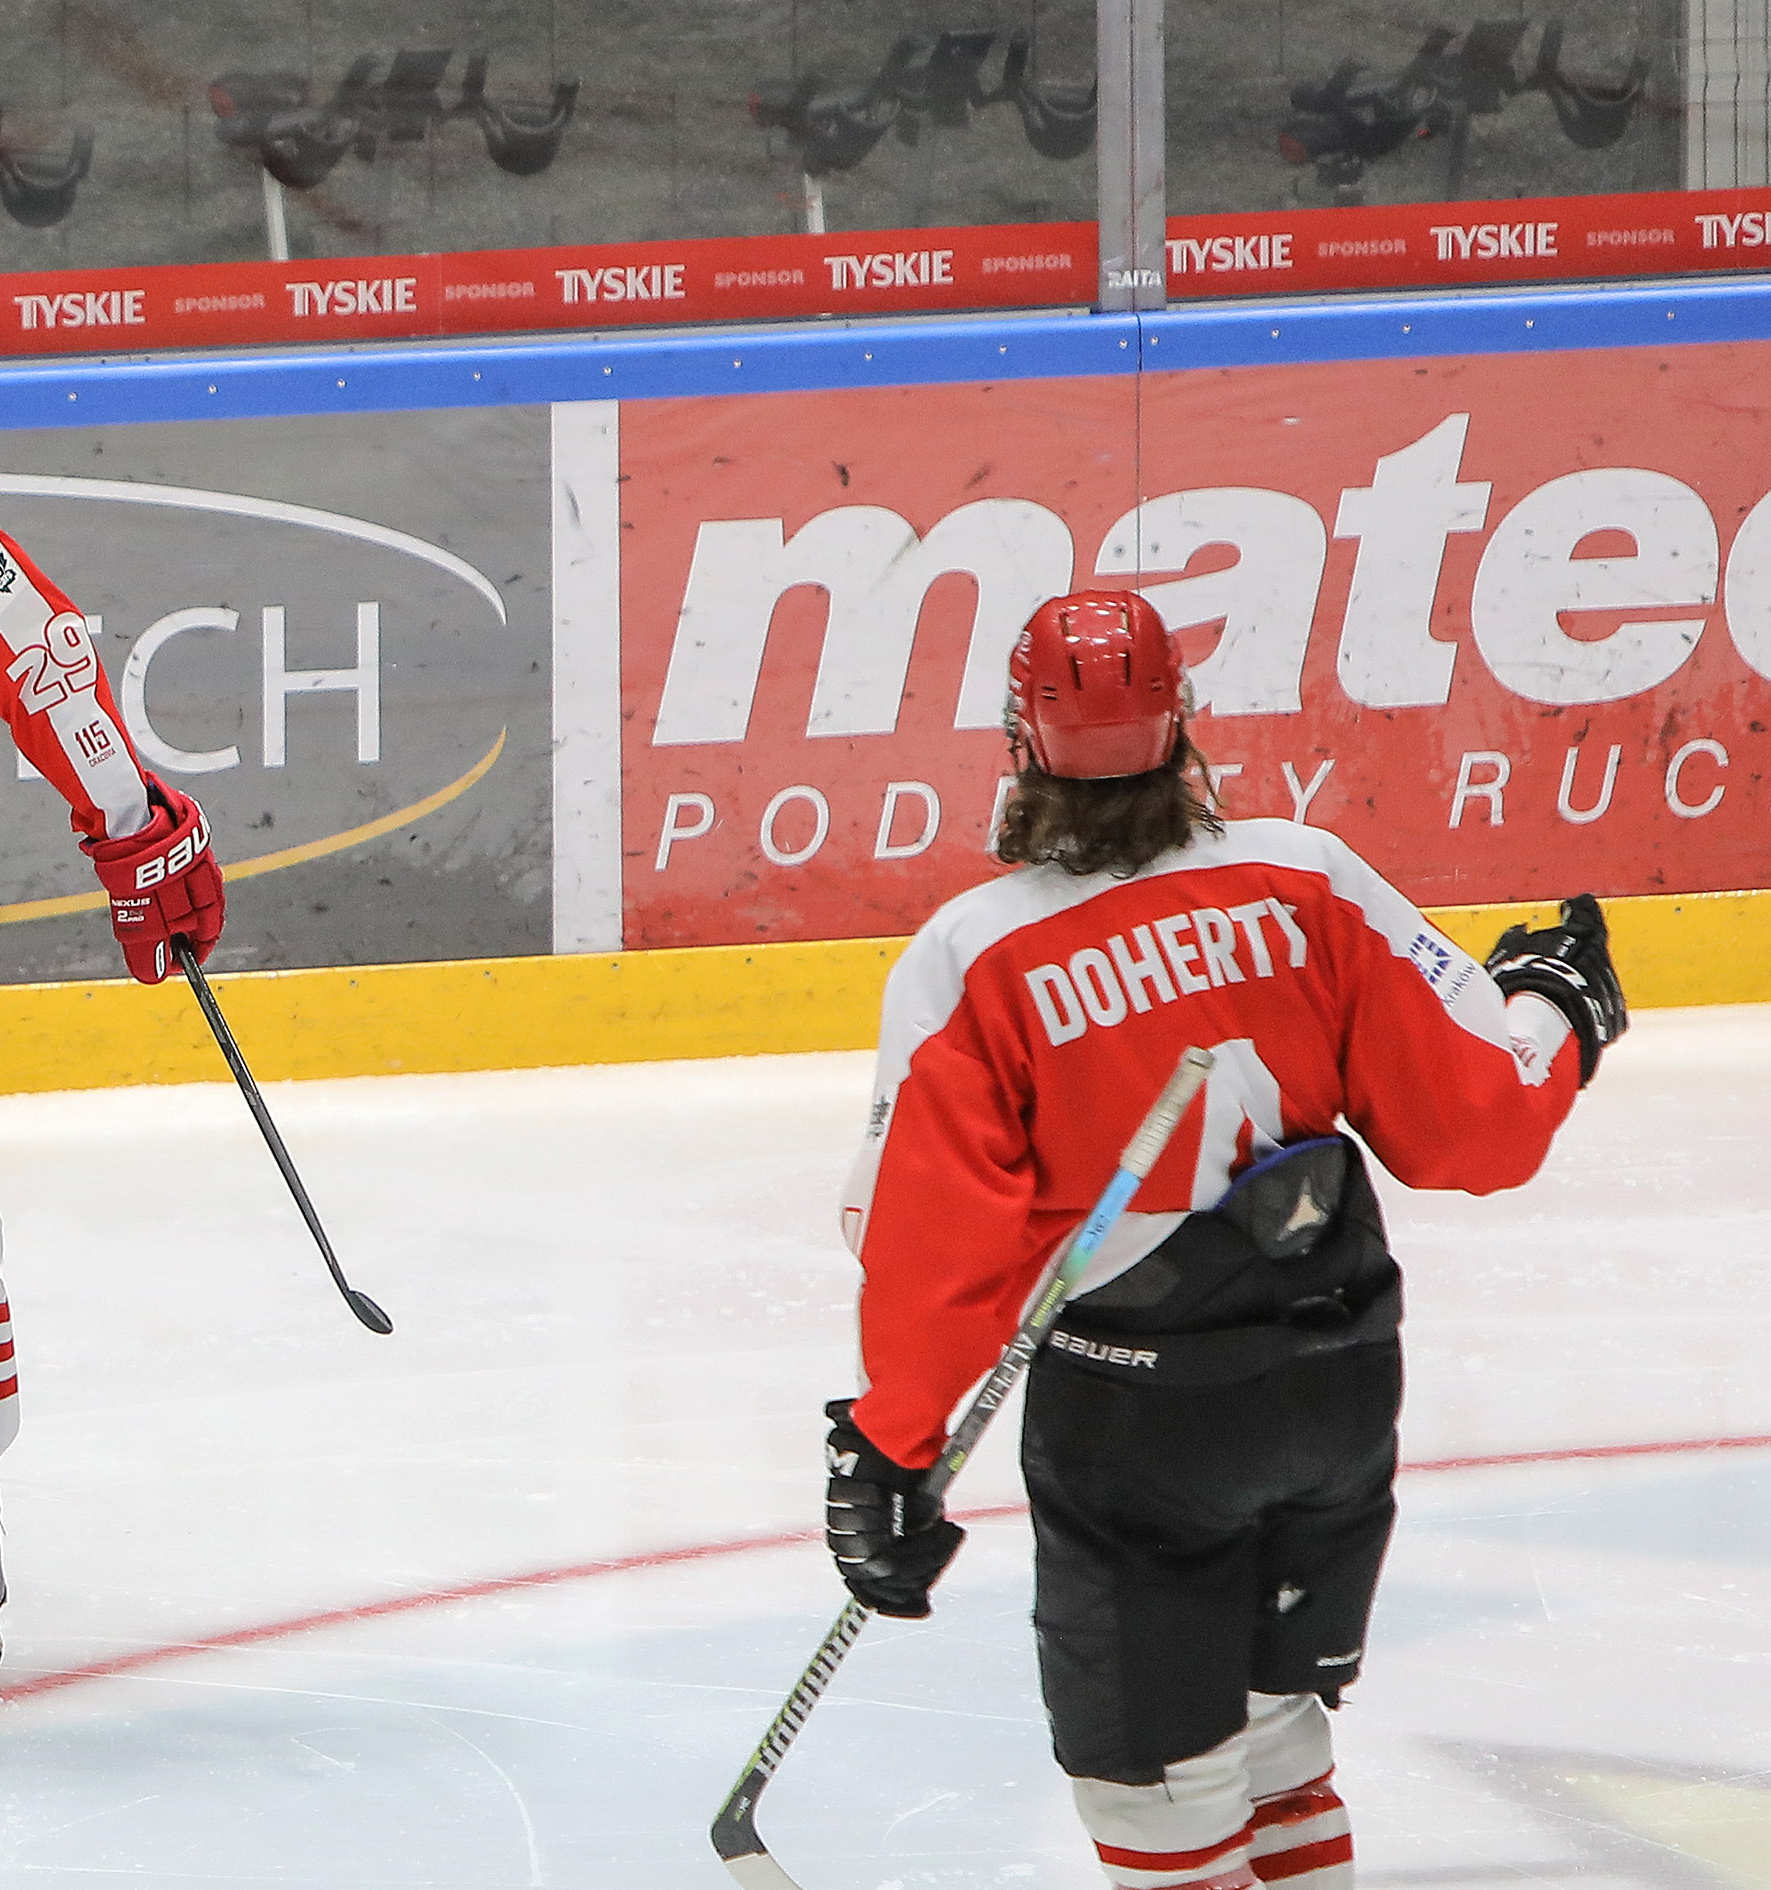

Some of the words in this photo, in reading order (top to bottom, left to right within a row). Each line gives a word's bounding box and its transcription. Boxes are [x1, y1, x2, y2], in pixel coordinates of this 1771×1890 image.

[1108, 268, 1162, 289] RAITA
[1164, 233, 1294, 274] TYSKIE
[1317, 238, 1407, 257] SPONSOR
[1430, 222, 1559, 260] TYSKIE
[1586, 228, 1675, 247] SPONSOR
[1694, 211, 1771, 249] TYS
[13, 290, 146, 329] TYSKIE
[174, 293, 266, 314] SPONSOR
[286, 277, 418, 317] TYSKIE
[444, 281, 536, 301] SPONSOR
[555, 264, 686, 304] TYSKIE
[714, 269, 805, 289] SPONSOR
[824, 249, 955, 290] TYSKIE
[981, 253, 1073, 275] SPONSOR
[652, 412, 1771, 747] mate
[6, 610, 99, 716] 29
[120, 601, 381, 776] CH
[74, 719, 111, 759] 115
[655, 758, 1335, 872] PODTY
[1449, 738, 1728, 829] RUC
[135, 812, 212, 890] BAU
[110, 897, 151, 907] NEXUS
[1024, 897, 1308, 1048] DOHERTY
[1049, 1328, 1159, 1370] BAUER
